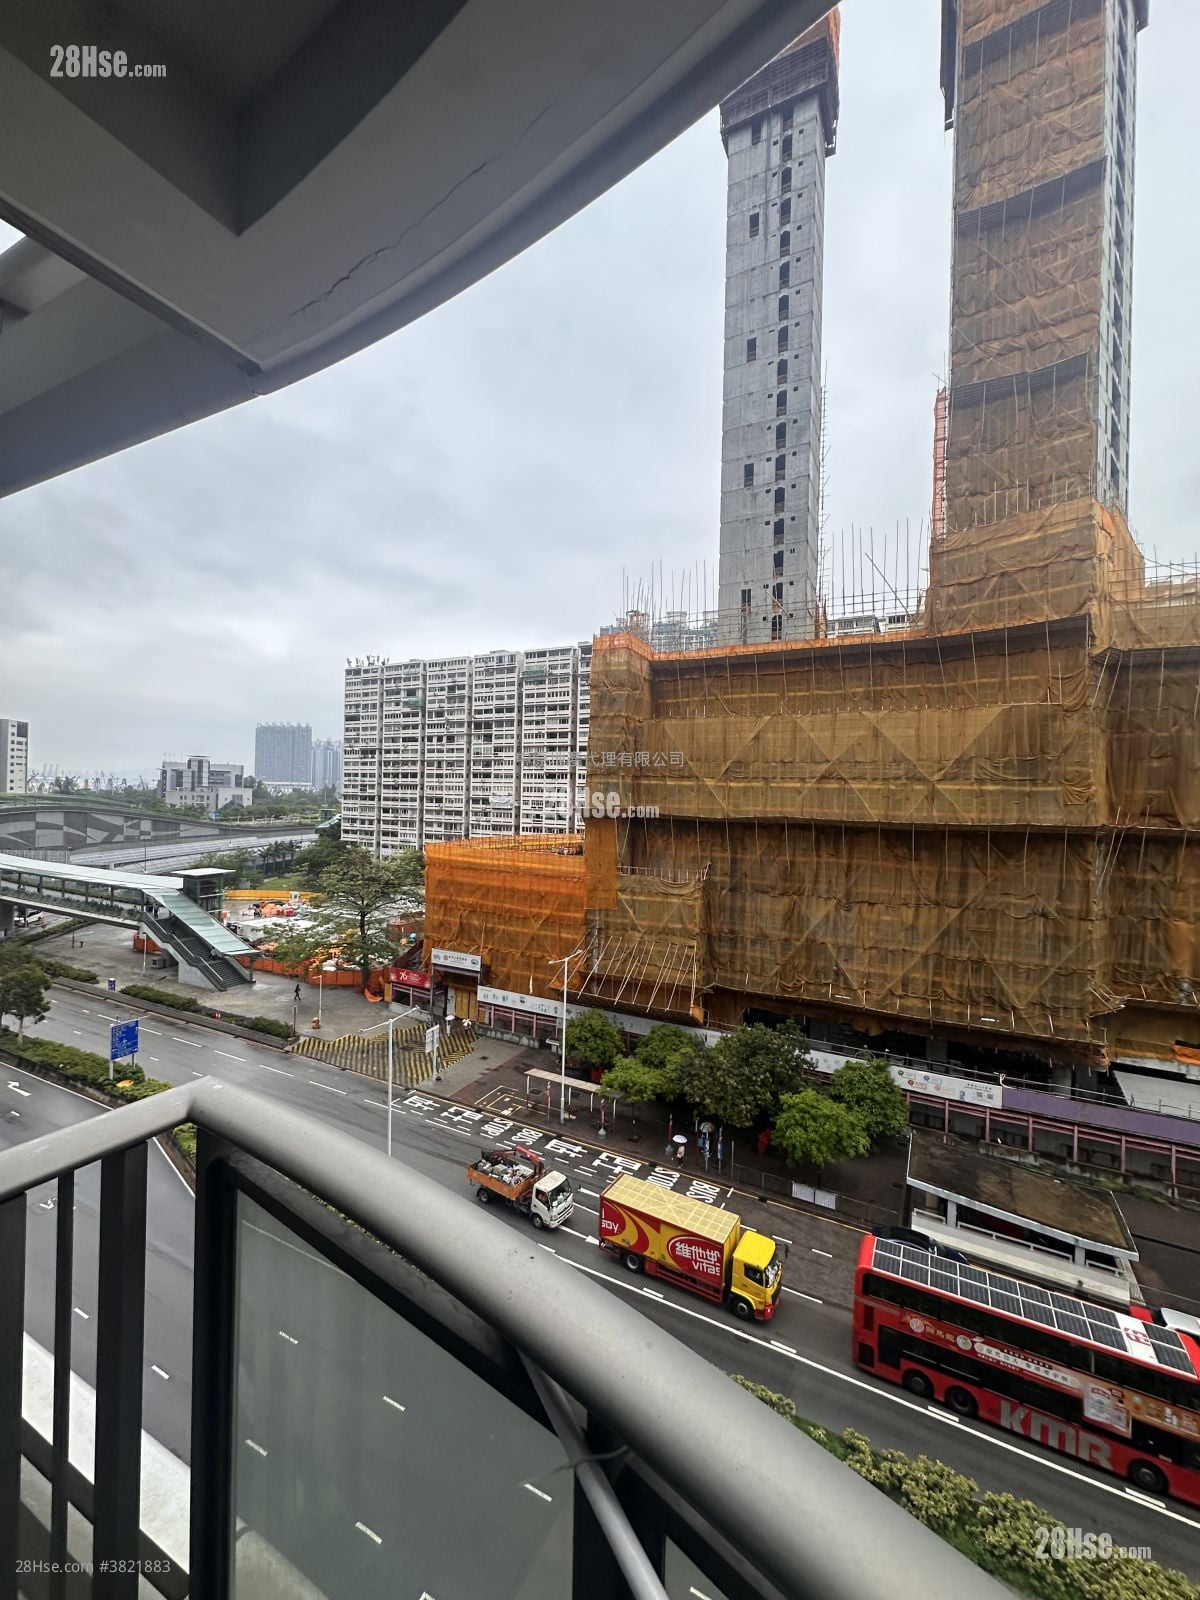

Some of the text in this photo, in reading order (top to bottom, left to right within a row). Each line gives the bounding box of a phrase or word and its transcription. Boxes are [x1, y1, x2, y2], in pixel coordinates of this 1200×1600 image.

[480, 1117, 514, 1137] STOP
[511, 1128, 544, 1145] BUS
[686, 1180, 720, 1203] BUS
